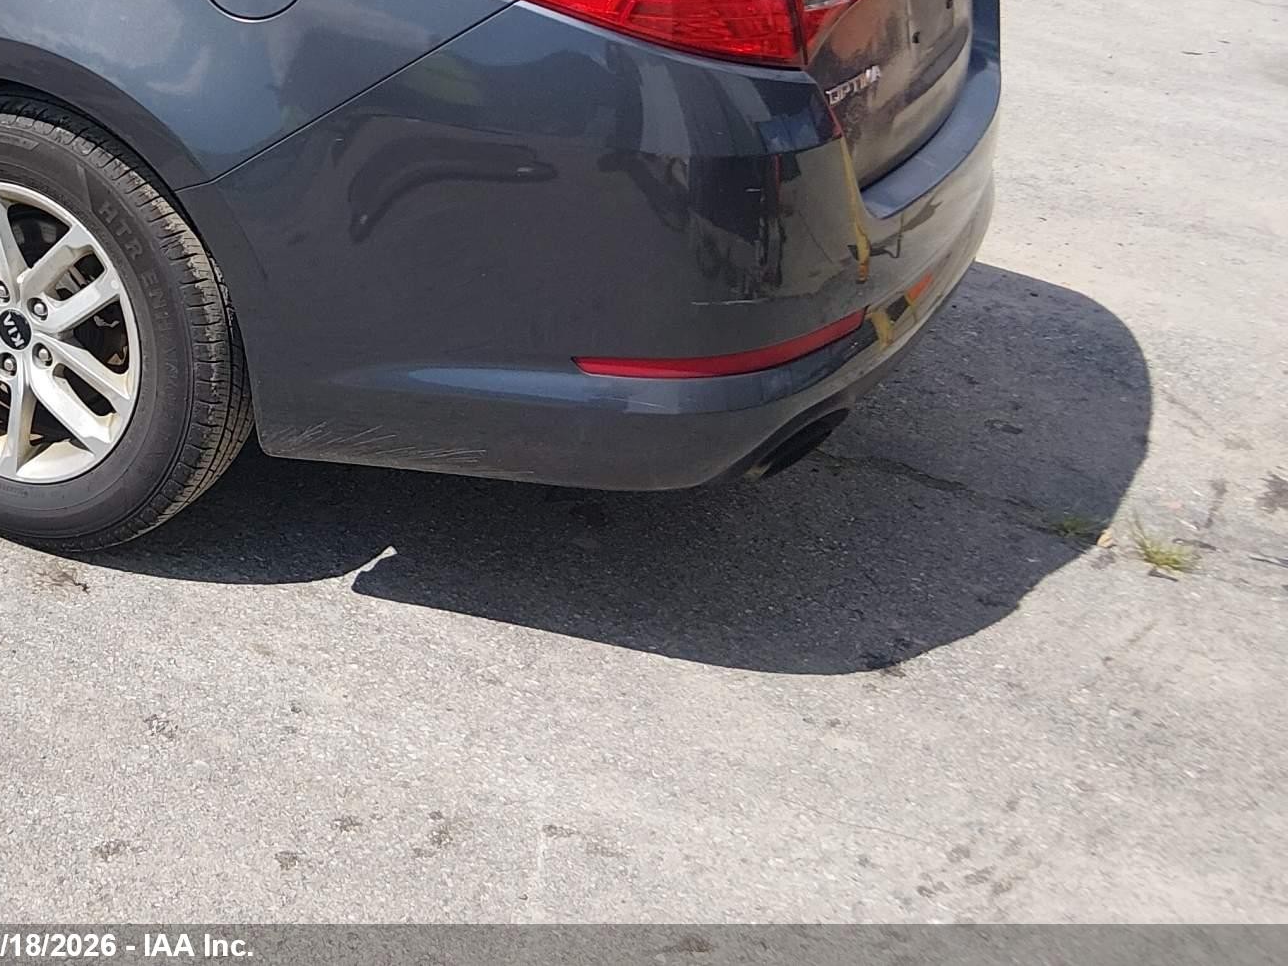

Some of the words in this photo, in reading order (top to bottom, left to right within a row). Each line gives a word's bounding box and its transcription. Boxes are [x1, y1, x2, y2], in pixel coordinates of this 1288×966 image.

[825, 65, 881, 106] OPTIMA
[98, 200, 143, 261] HTR
[3, 313, 25, 347] KIA
